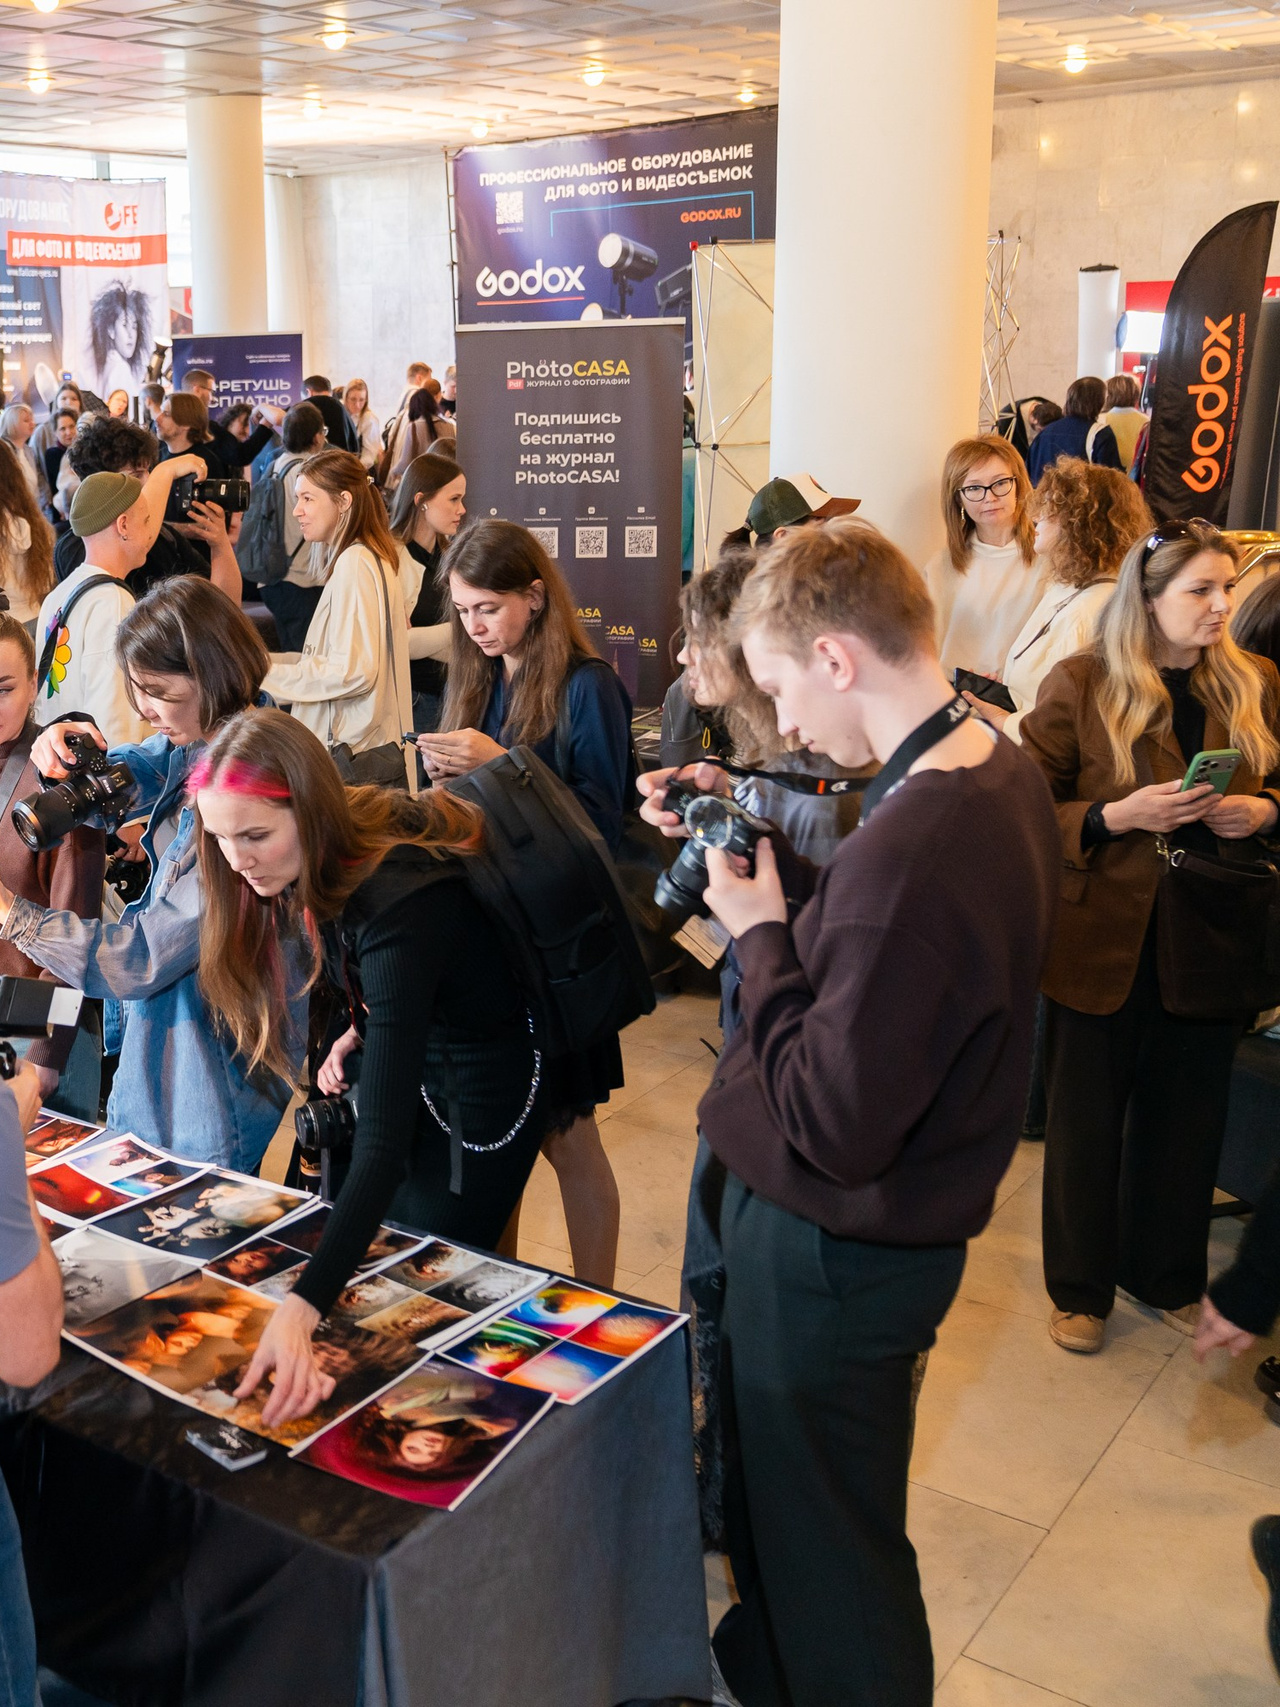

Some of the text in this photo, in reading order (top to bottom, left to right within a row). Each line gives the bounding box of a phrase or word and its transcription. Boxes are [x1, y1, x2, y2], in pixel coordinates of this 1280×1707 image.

[479, 143, 753, 187] ПРОФЕССИОНАЛЬНОЕ ОБОРУДОВАНИЕ
[544, 165, 753, 203] ДЛЯ ФОТО И ВИДЕОСЪЕМОК
[680, 207, 742, 224] GODOX.RU
[12, 238, 35, 259] ДЛЯ
[36, 239, 63, 258] ФОТО
[475, 259, 585, 298] Godox
[1238, 312, 1246, 347] solutions
[1235, 348, 1245, 376] lighting
[564, 379, 571, 387] О
[572, 377, 630, 387] ФОТОГРАФИИ
[1233, 377, 1241, 405] cinema
[1181, 314, 1233, 494] Godox
[514, 412, 621, 427] Подпишись
[519, 431, 616, 446] бесплатно
[519, 452, 615, 468] на журнал
[515, 469, 621, 485] PhotoCASA!
